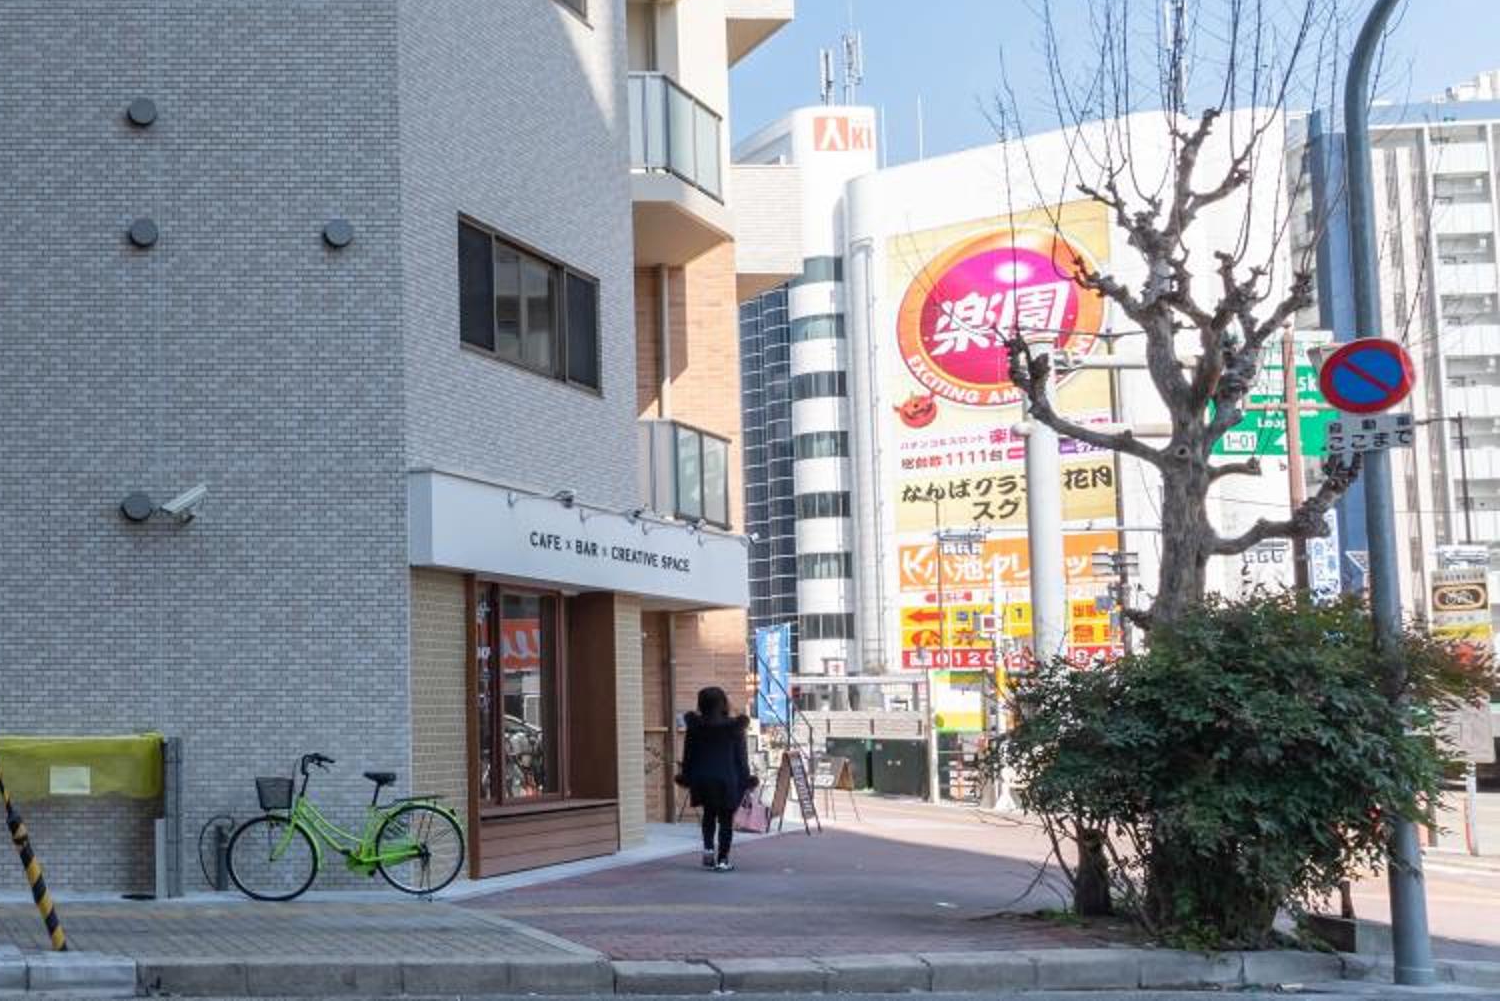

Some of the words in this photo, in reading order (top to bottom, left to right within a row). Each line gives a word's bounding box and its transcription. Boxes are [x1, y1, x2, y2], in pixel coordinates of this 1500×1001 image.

[930, 281, 1071, 356] 楽園
[906, 354, 980, 403] EXCITING
[1329, 429, 1413, 451] ここまで
[529, 531, 562, 550] CAFE
[576, 540, 599, 557] BAR
[611, 546, 658, 568] CREATIVE
[661, 555, 690, 572] SPACE
